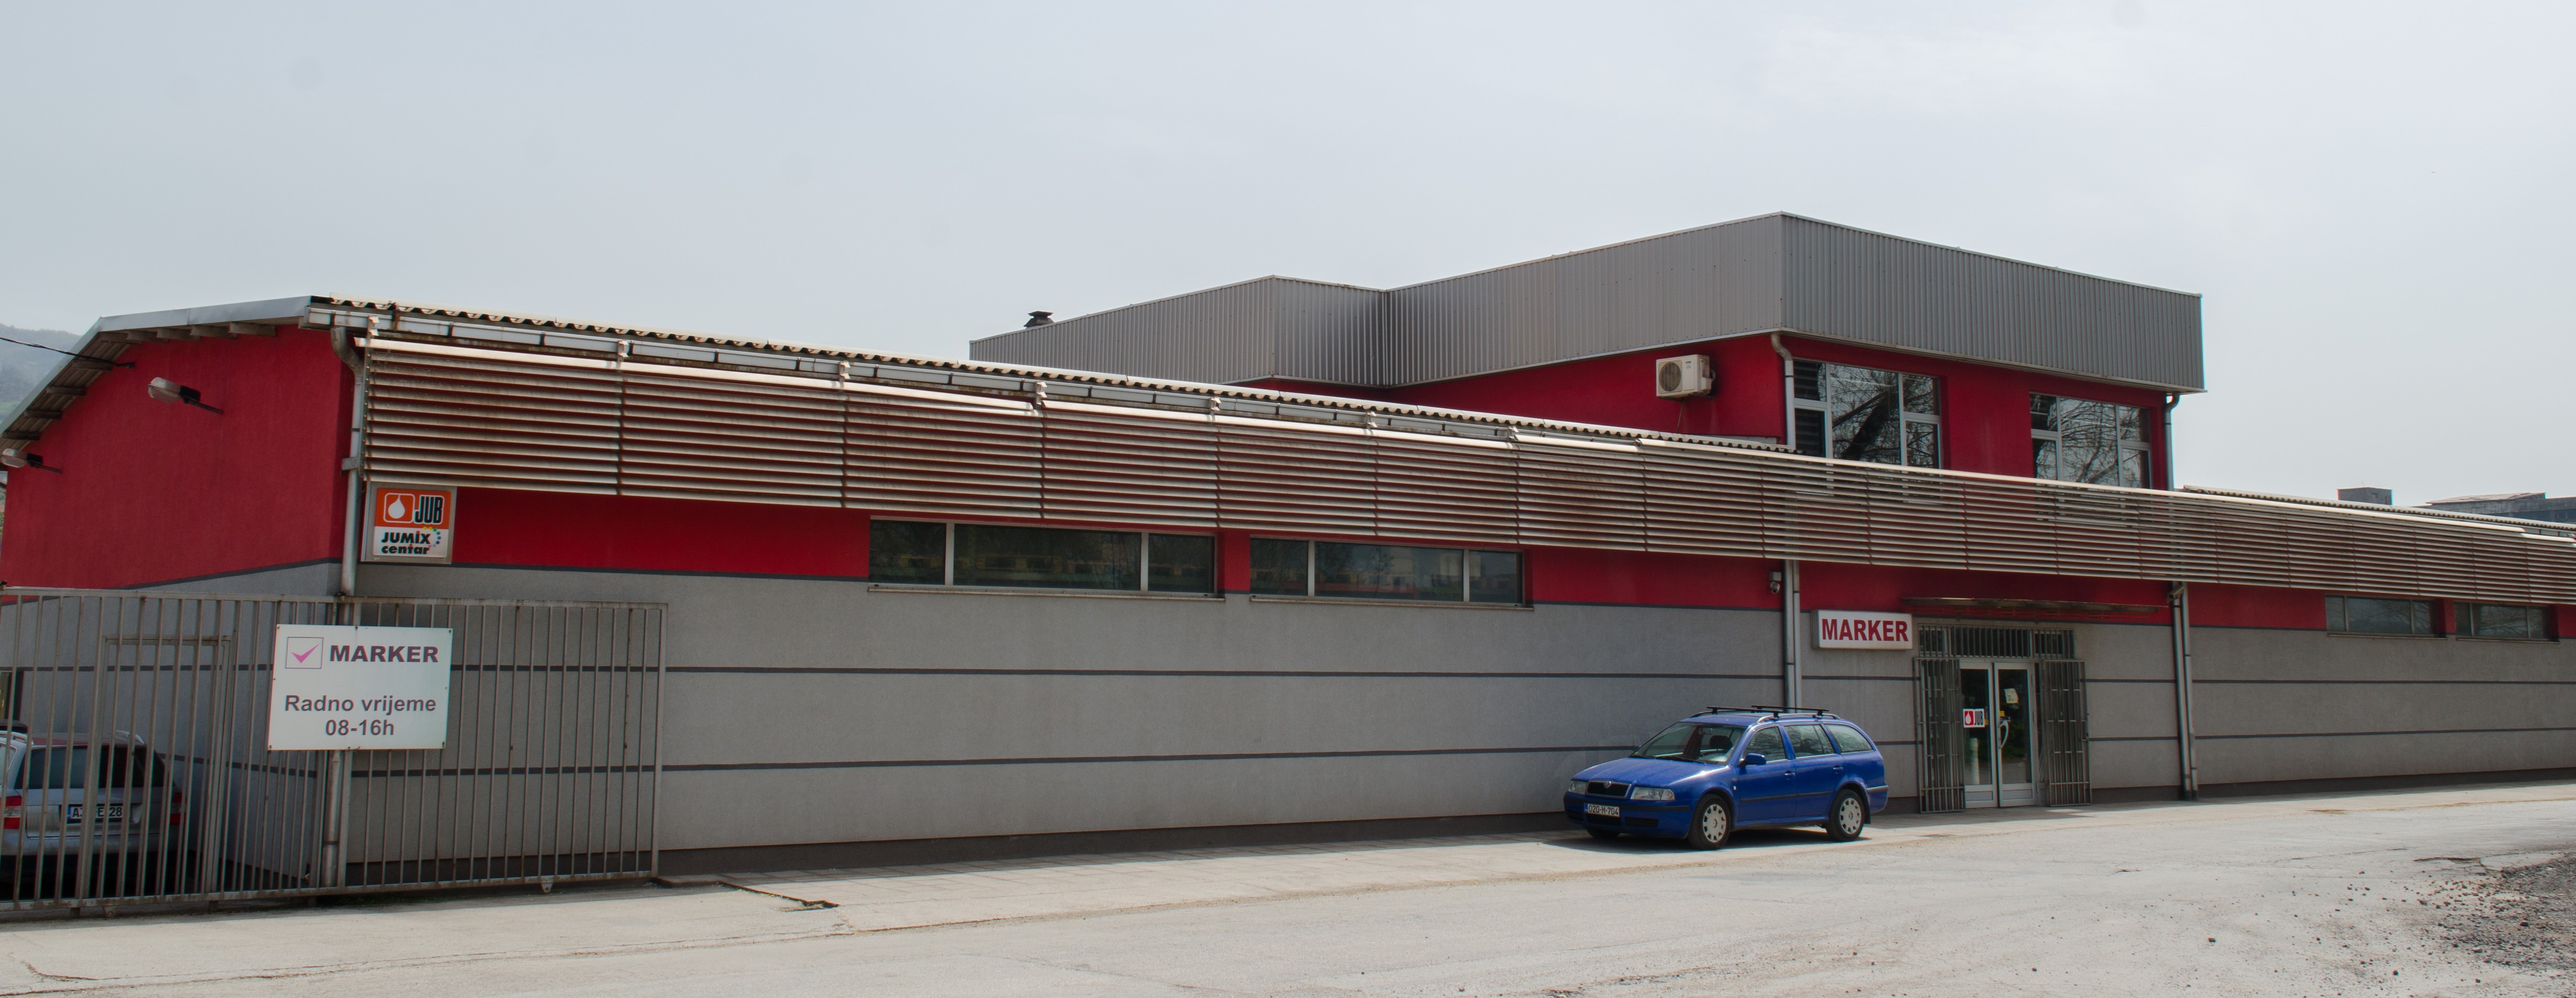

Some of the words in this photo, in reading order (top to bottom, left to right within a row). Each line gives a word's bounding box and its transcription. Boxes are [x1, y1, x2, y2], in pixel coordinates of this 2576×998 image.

[414, 495, 444, 524] JUB
[381, 544, 430, 554] centar
[1822, 619, 1909, 642] MARKER
[330, 645, 439, 663] MARKER
[285, 694, 354, 711] Radno
[361, 695, 436, 715] vrijeme
[1974, 711, 1984, 725] JUB
[326, 719, 395, 736] 08-16h
